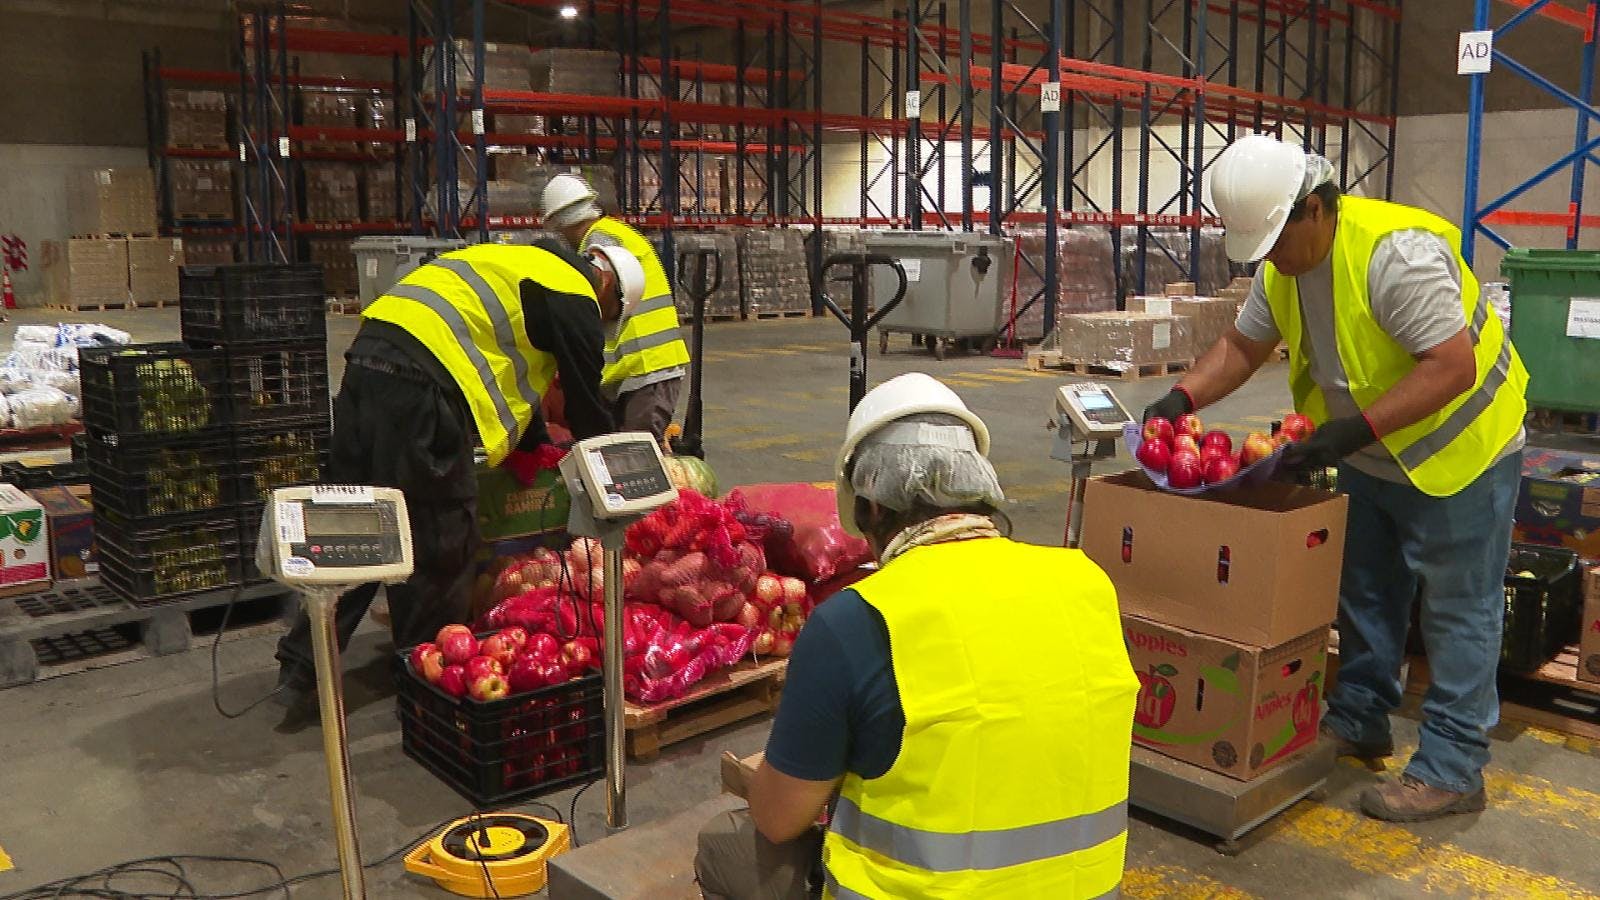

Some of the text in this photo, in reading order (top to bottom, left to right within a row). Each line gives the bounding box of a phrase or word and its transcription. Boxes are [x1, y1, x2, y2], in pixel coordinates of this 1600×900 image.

[1461, 41, 1489, 60] AD
[1042, 89, 1058, 102] AD
[1126, 627, 1188, 657] Apples
